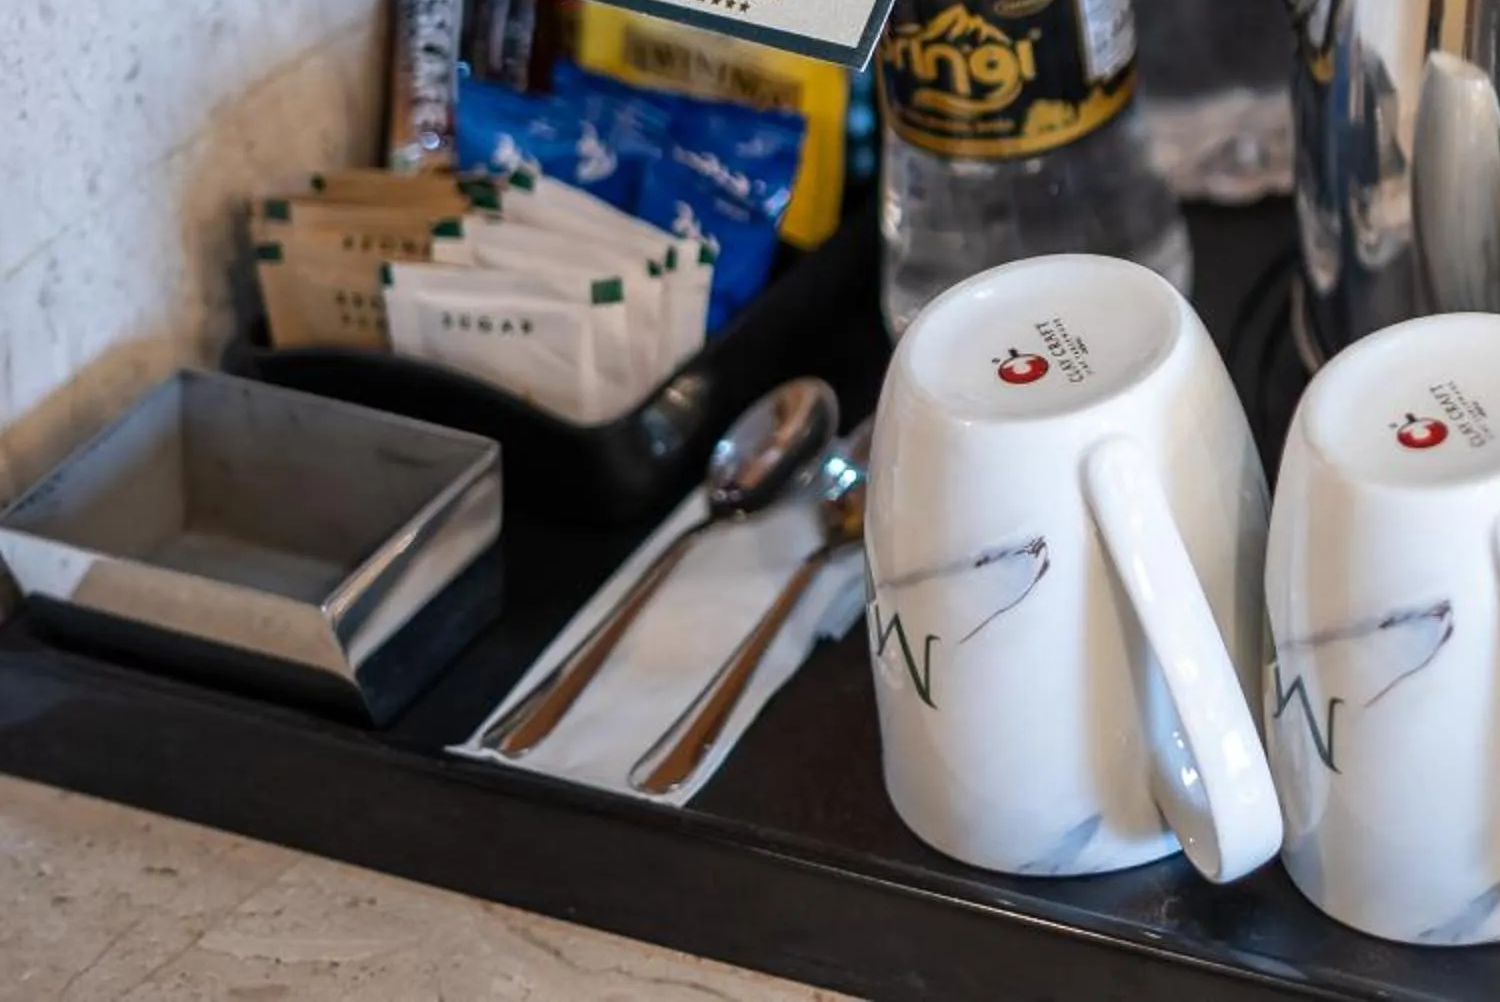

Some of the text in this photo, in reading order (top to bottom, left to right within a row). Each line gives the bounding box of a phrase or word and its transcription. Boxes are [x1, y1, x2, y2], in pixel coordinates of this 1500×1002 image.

[1035, 321, 1067, 357] CRAFT
[1058, 359, 1085, 383] CLAY
[1430, 384, 1465, 421] CRAFT
[1458, 421, 1487, 448] CLAY
